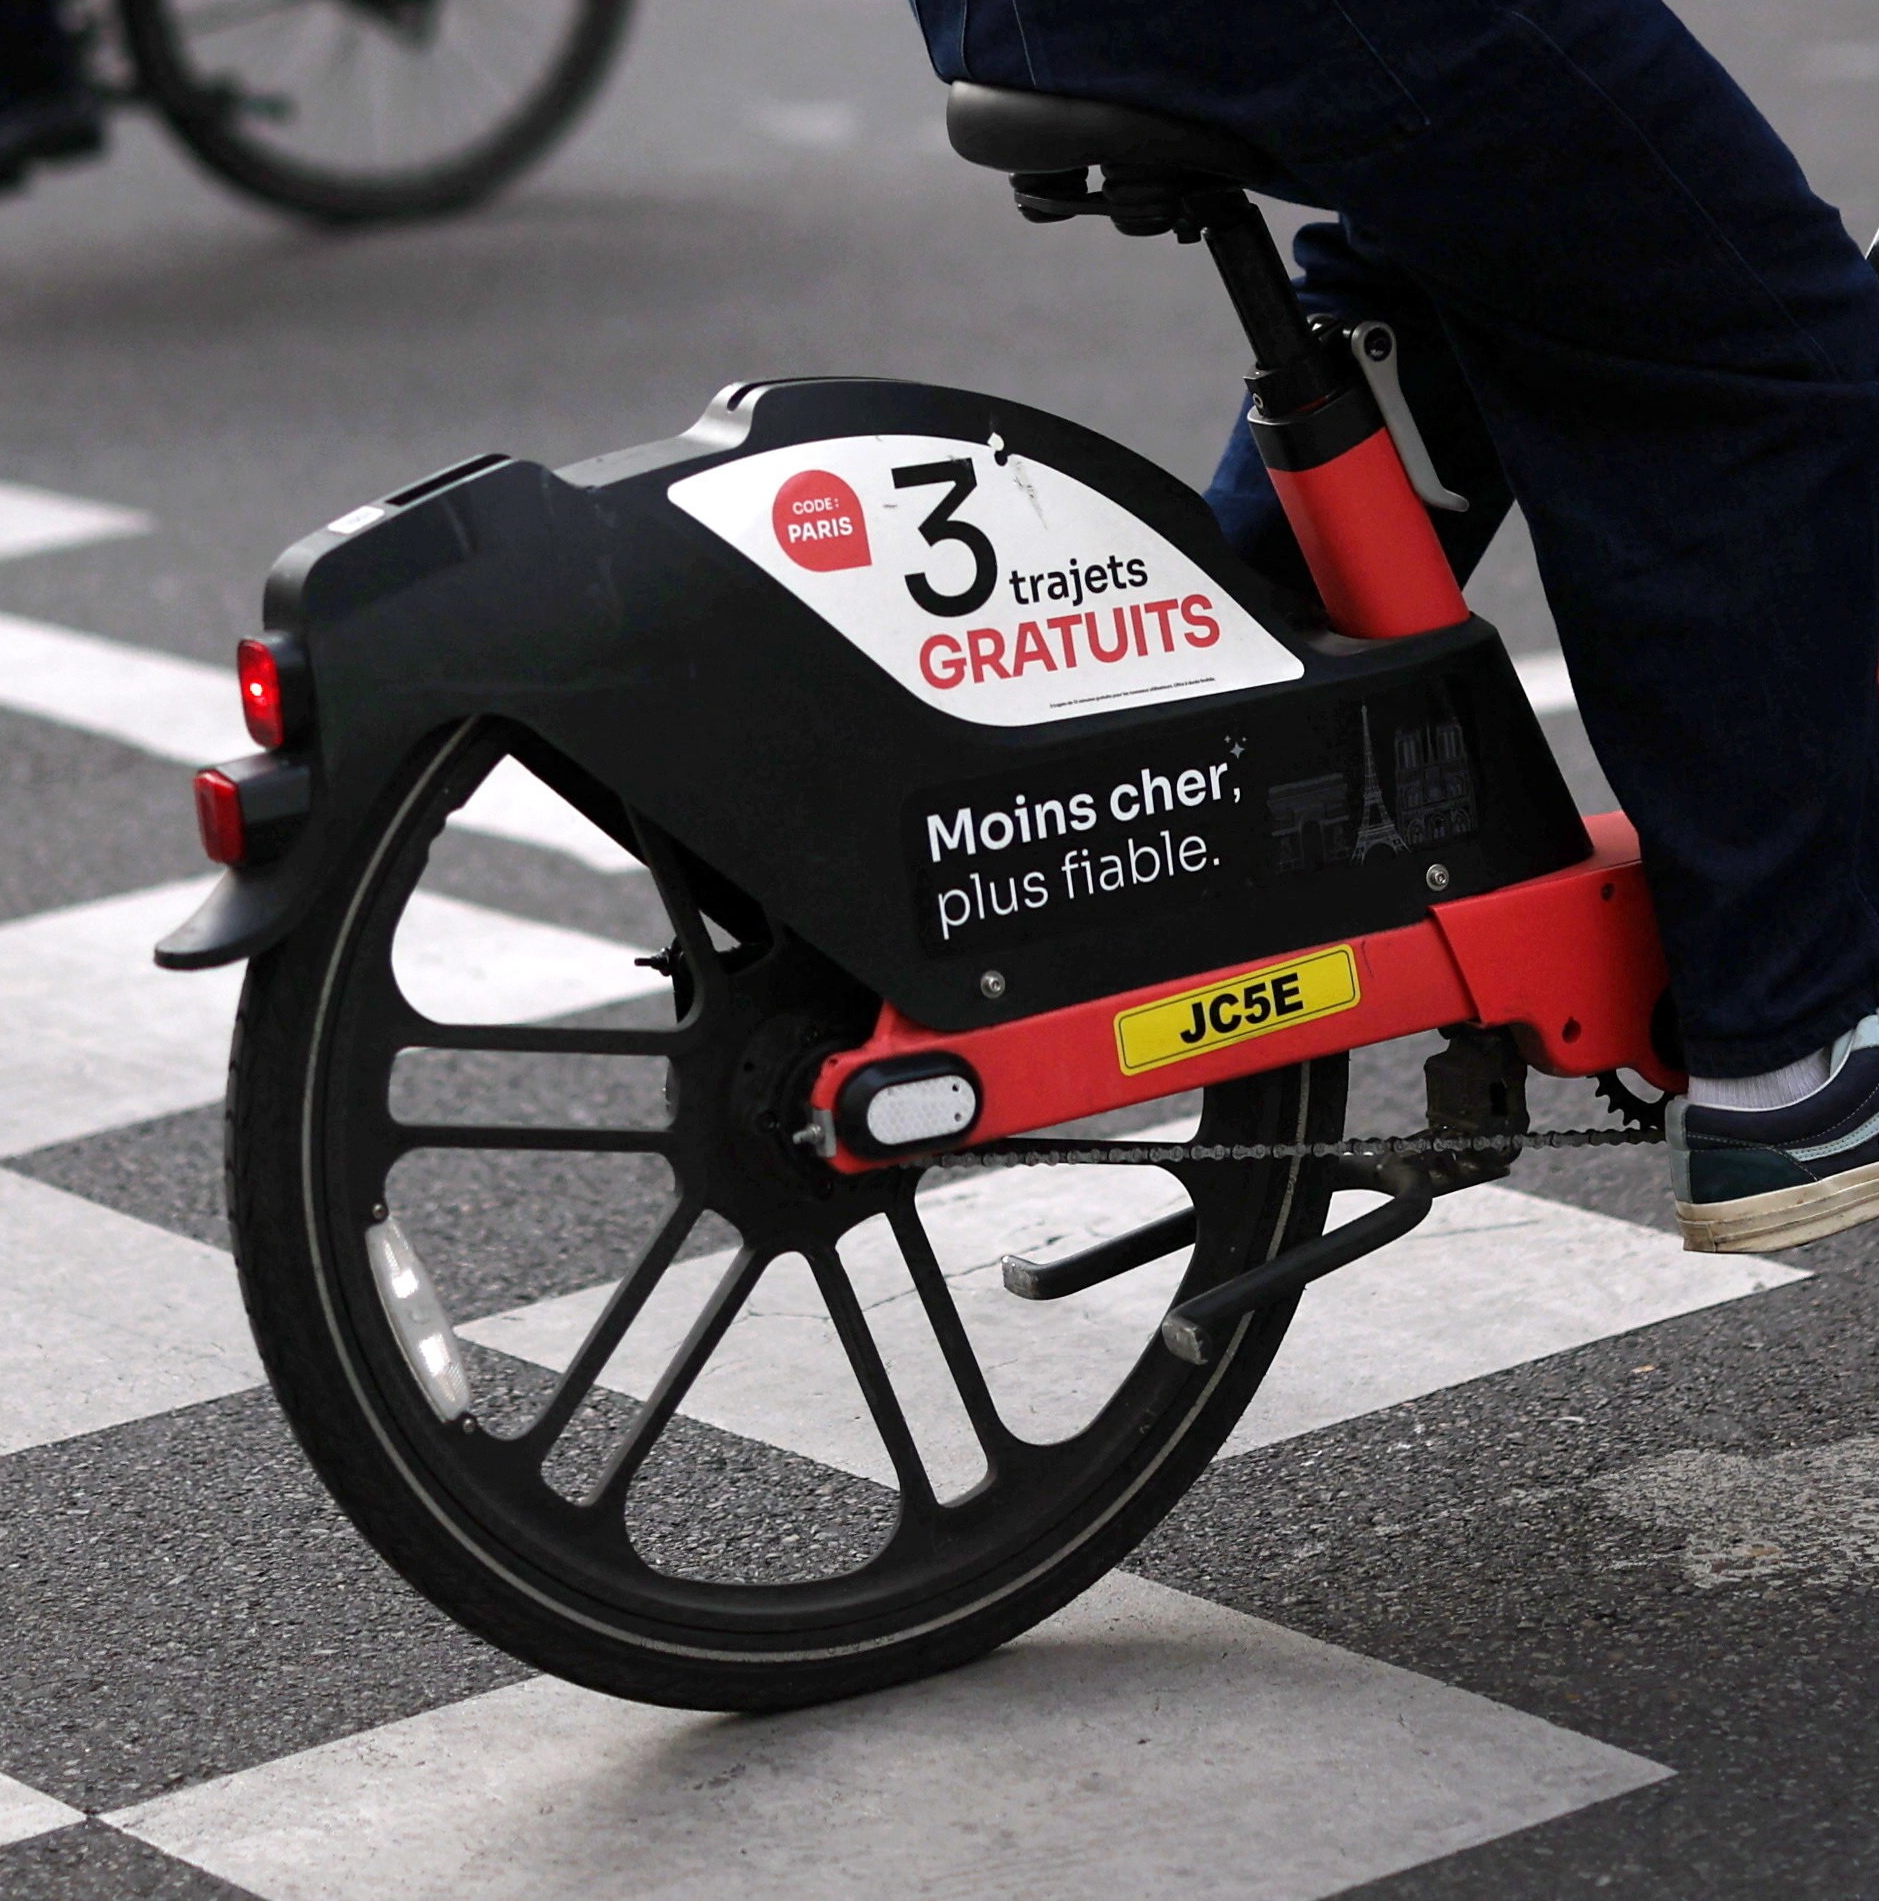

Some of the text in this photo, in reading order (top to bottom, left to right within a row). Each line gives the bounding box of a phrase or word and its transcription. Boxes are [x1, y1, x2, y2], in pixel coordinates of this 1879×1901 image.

[787, 516, 853, 543] PARIS
[792, 497, 840, 515] CODE:
[891, 457, 1148, 617] 3 trajets
[919, 594, 1220, 690] GRATUITS
[926, 762, 1241, 863] Moins cher,
[938, 829, 1220, 940] plus fiable.
[1180, 972, 1304, 1044] JC5E
